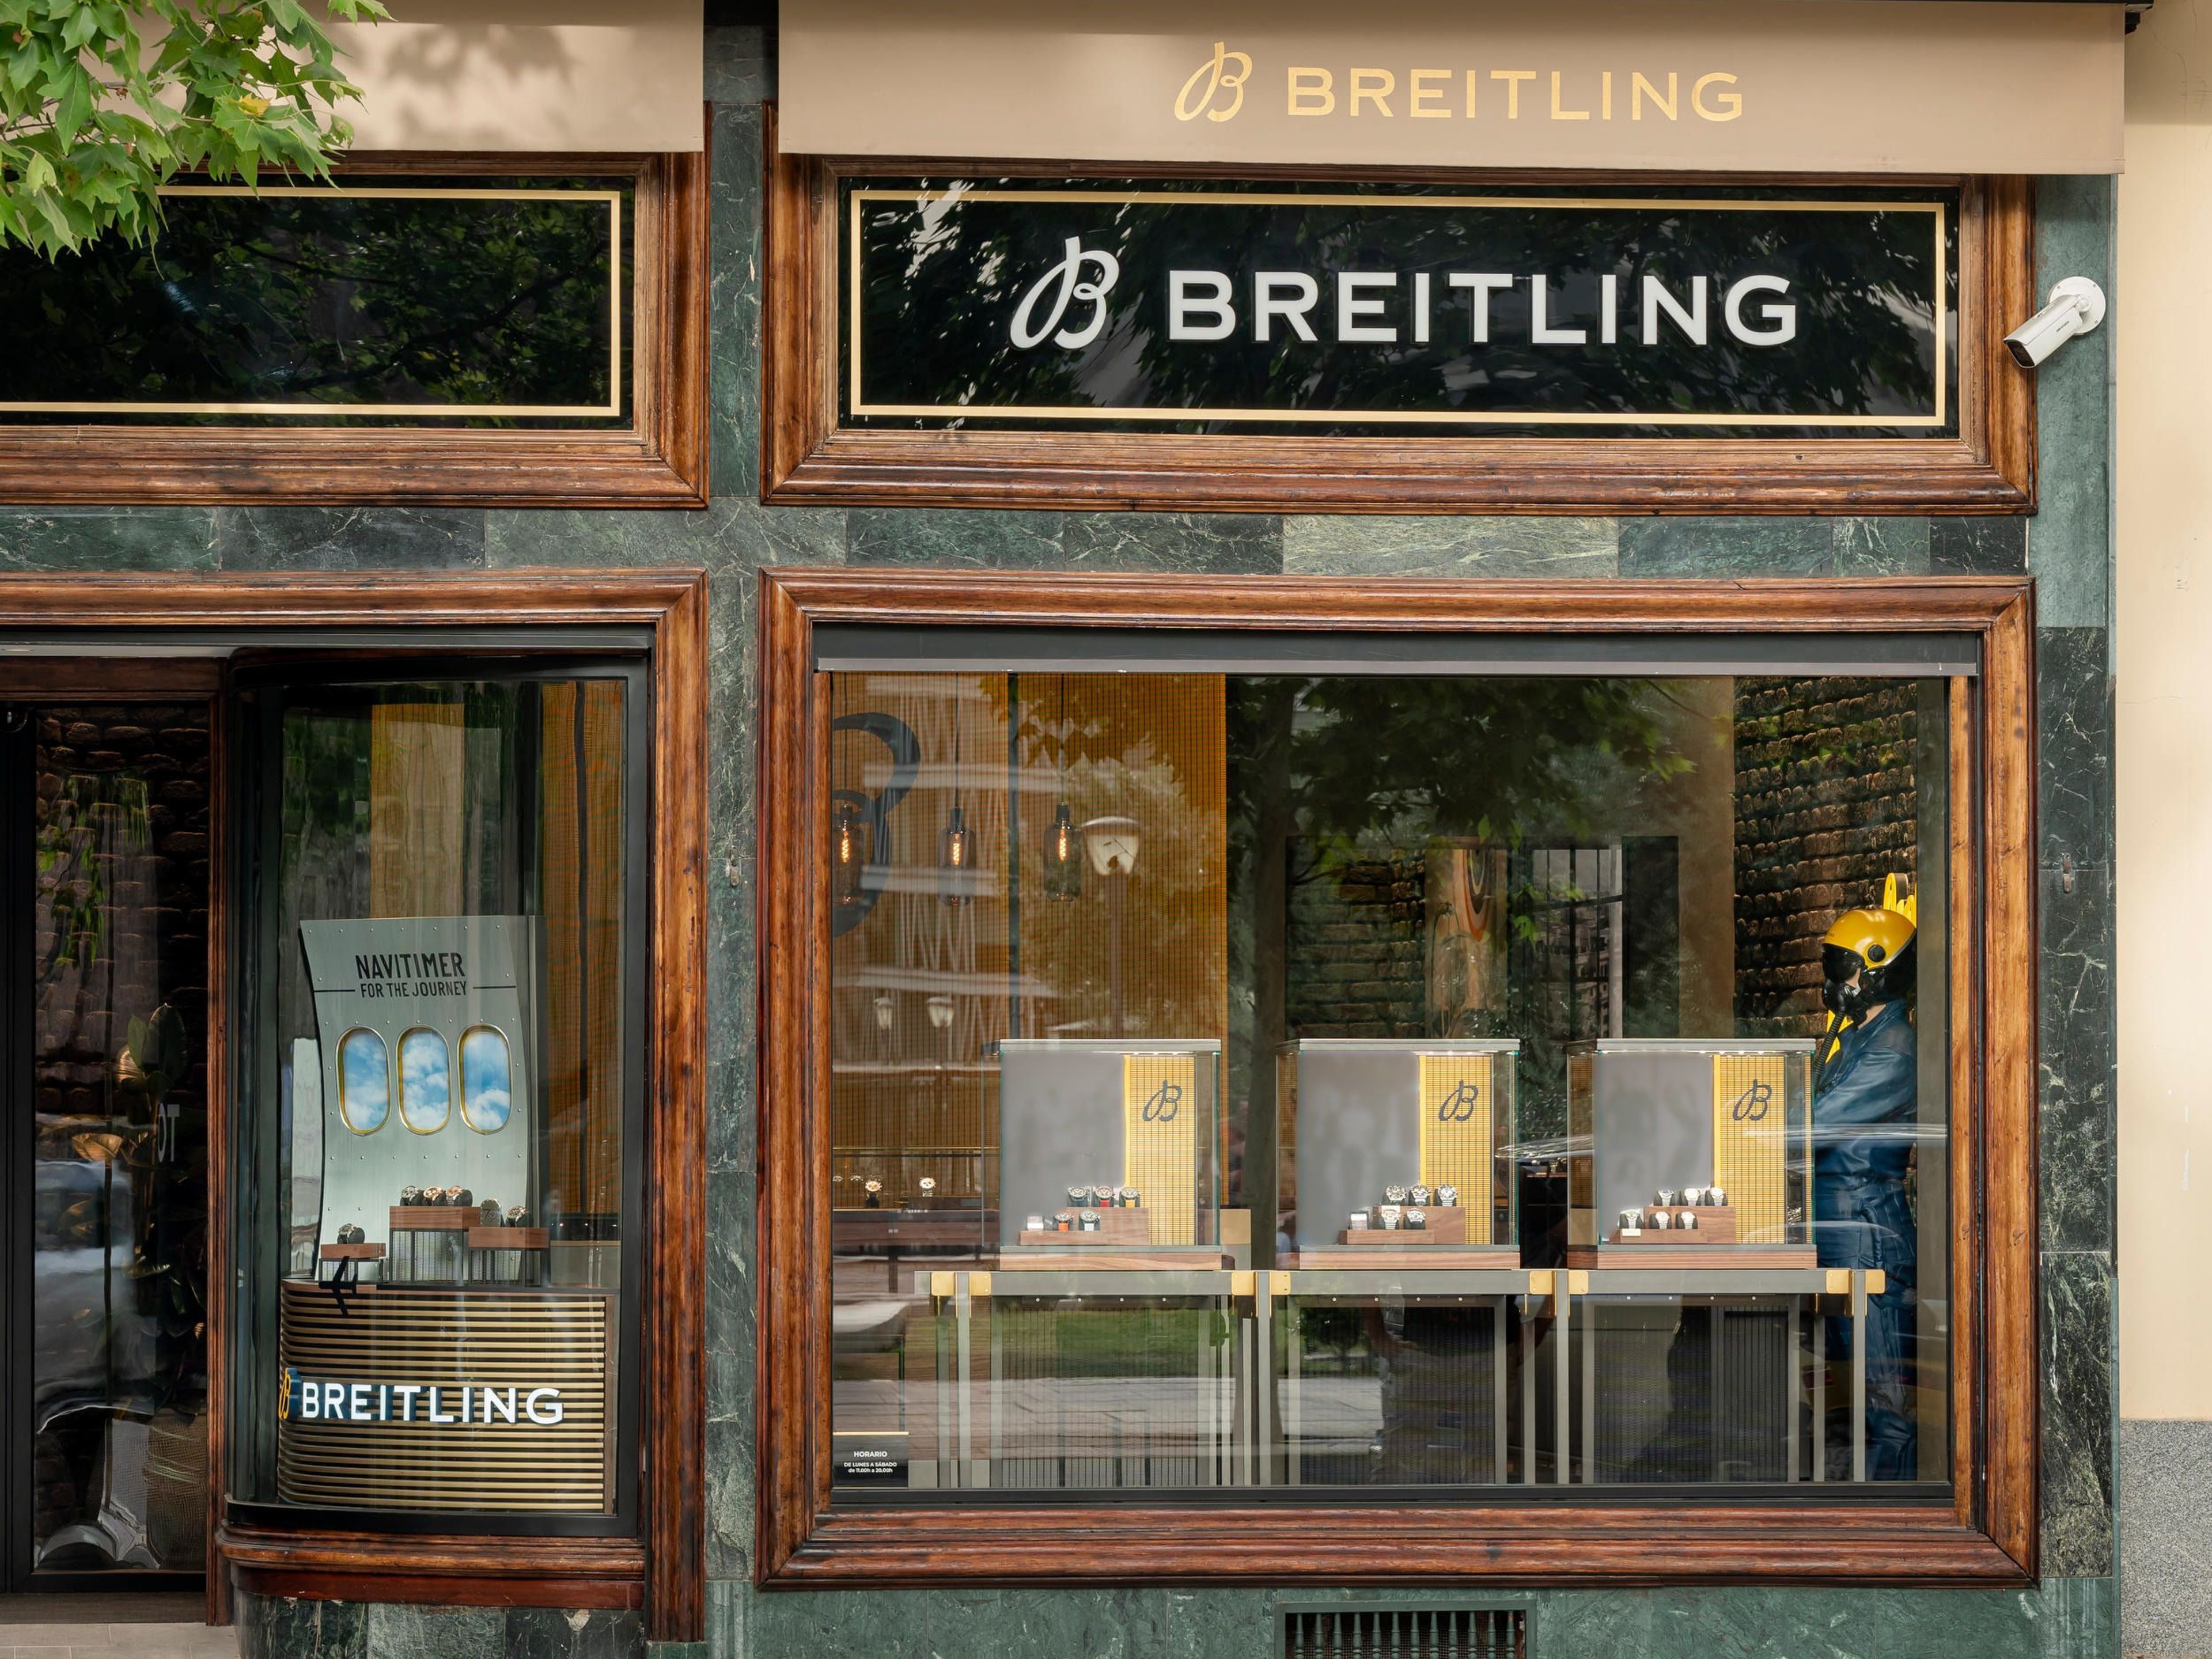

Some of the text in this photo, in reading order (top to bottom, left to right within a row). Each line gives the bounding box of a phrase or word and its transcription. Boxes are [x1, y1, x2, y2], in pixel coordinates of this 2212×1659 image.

[1287, 66, 1744, 122] BREITLING
[1169, 270, 1798, 347] BREITLING
[355, 952, 465, 979] NAVITIMER
[361, 980, 467, 998] FOR THE JOURNEY
[302, 1382, 563, 1425] BREITLING
